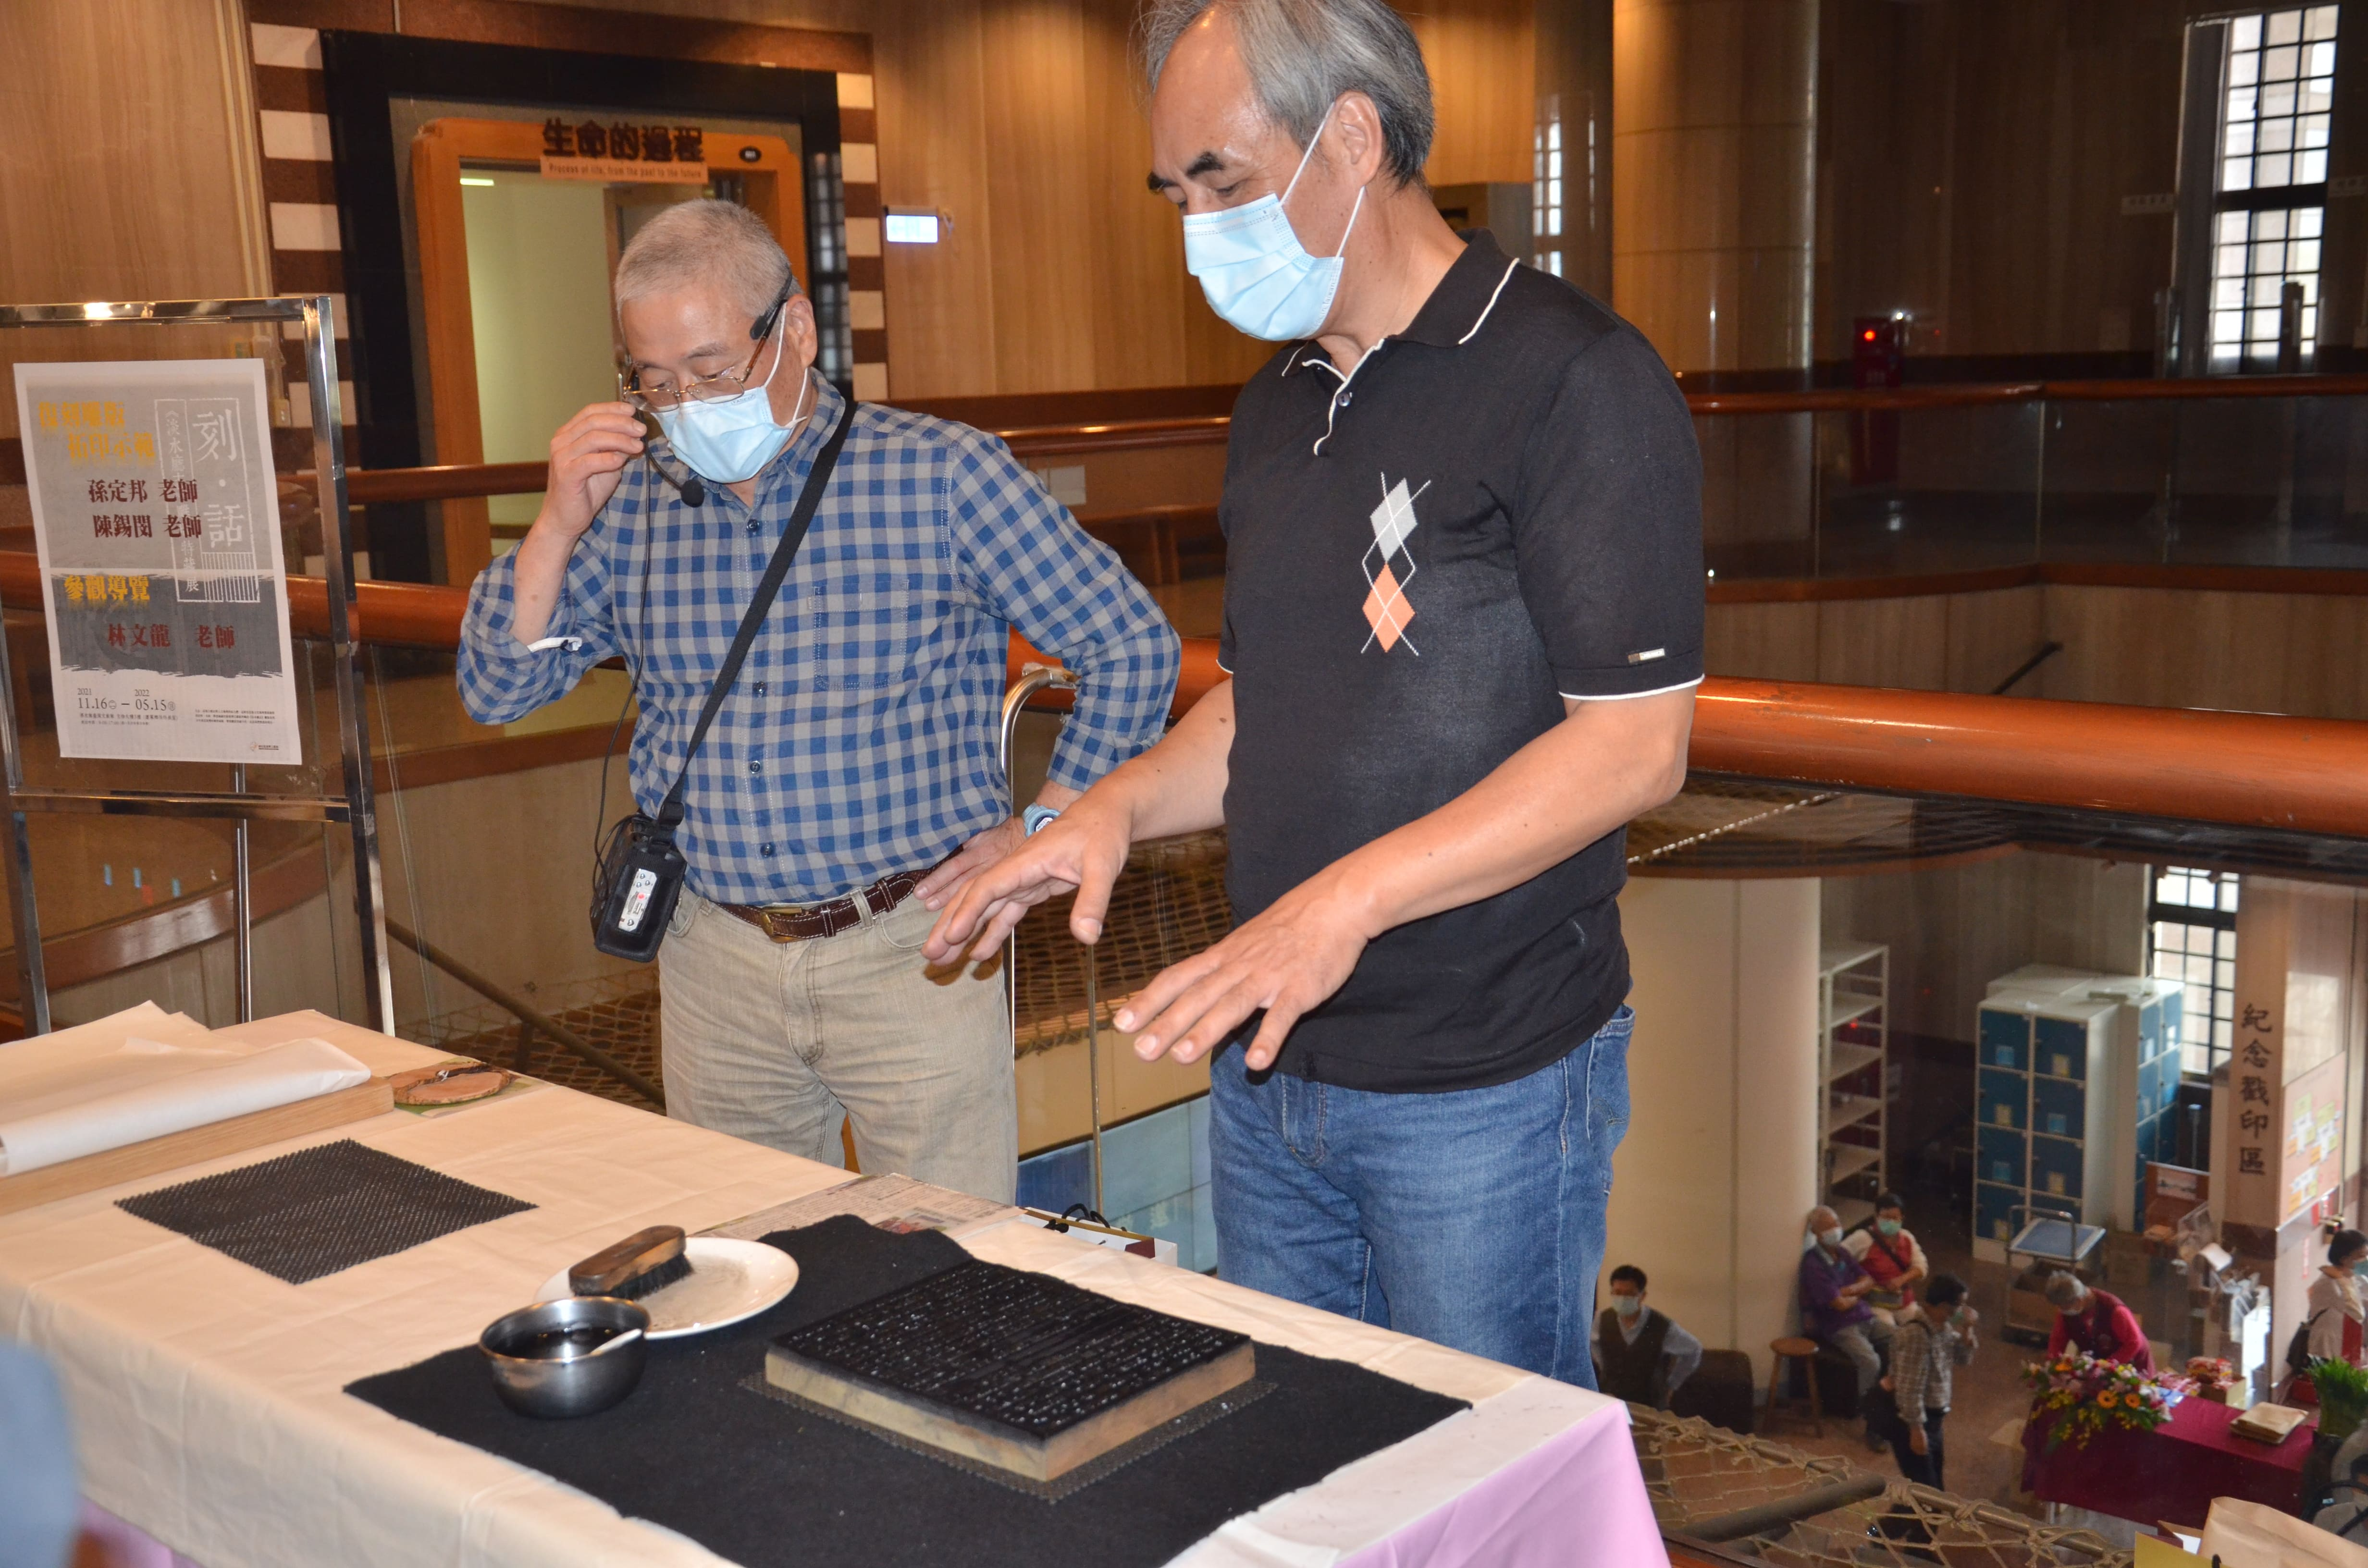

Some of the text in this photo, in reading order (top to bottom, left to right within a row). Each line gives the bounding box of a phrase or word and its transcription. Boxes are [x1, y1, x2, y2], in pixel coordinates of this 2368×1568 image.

[543, 117, 705, 162] 生命的過程
[68, 432, 156, 459] 拓印示範
[86, 478, 198, 503] 孫定邦 老師
[92, 514, 202, 539] 陳錫閔 老師
[64, 574, 150, 601] 參觀導覽
[108, 623, 235, 649] 林文龍 老師
[77, 687, 92, 696] 2021
[2239, 1002, 2273, 1176] 紀念戳印區
